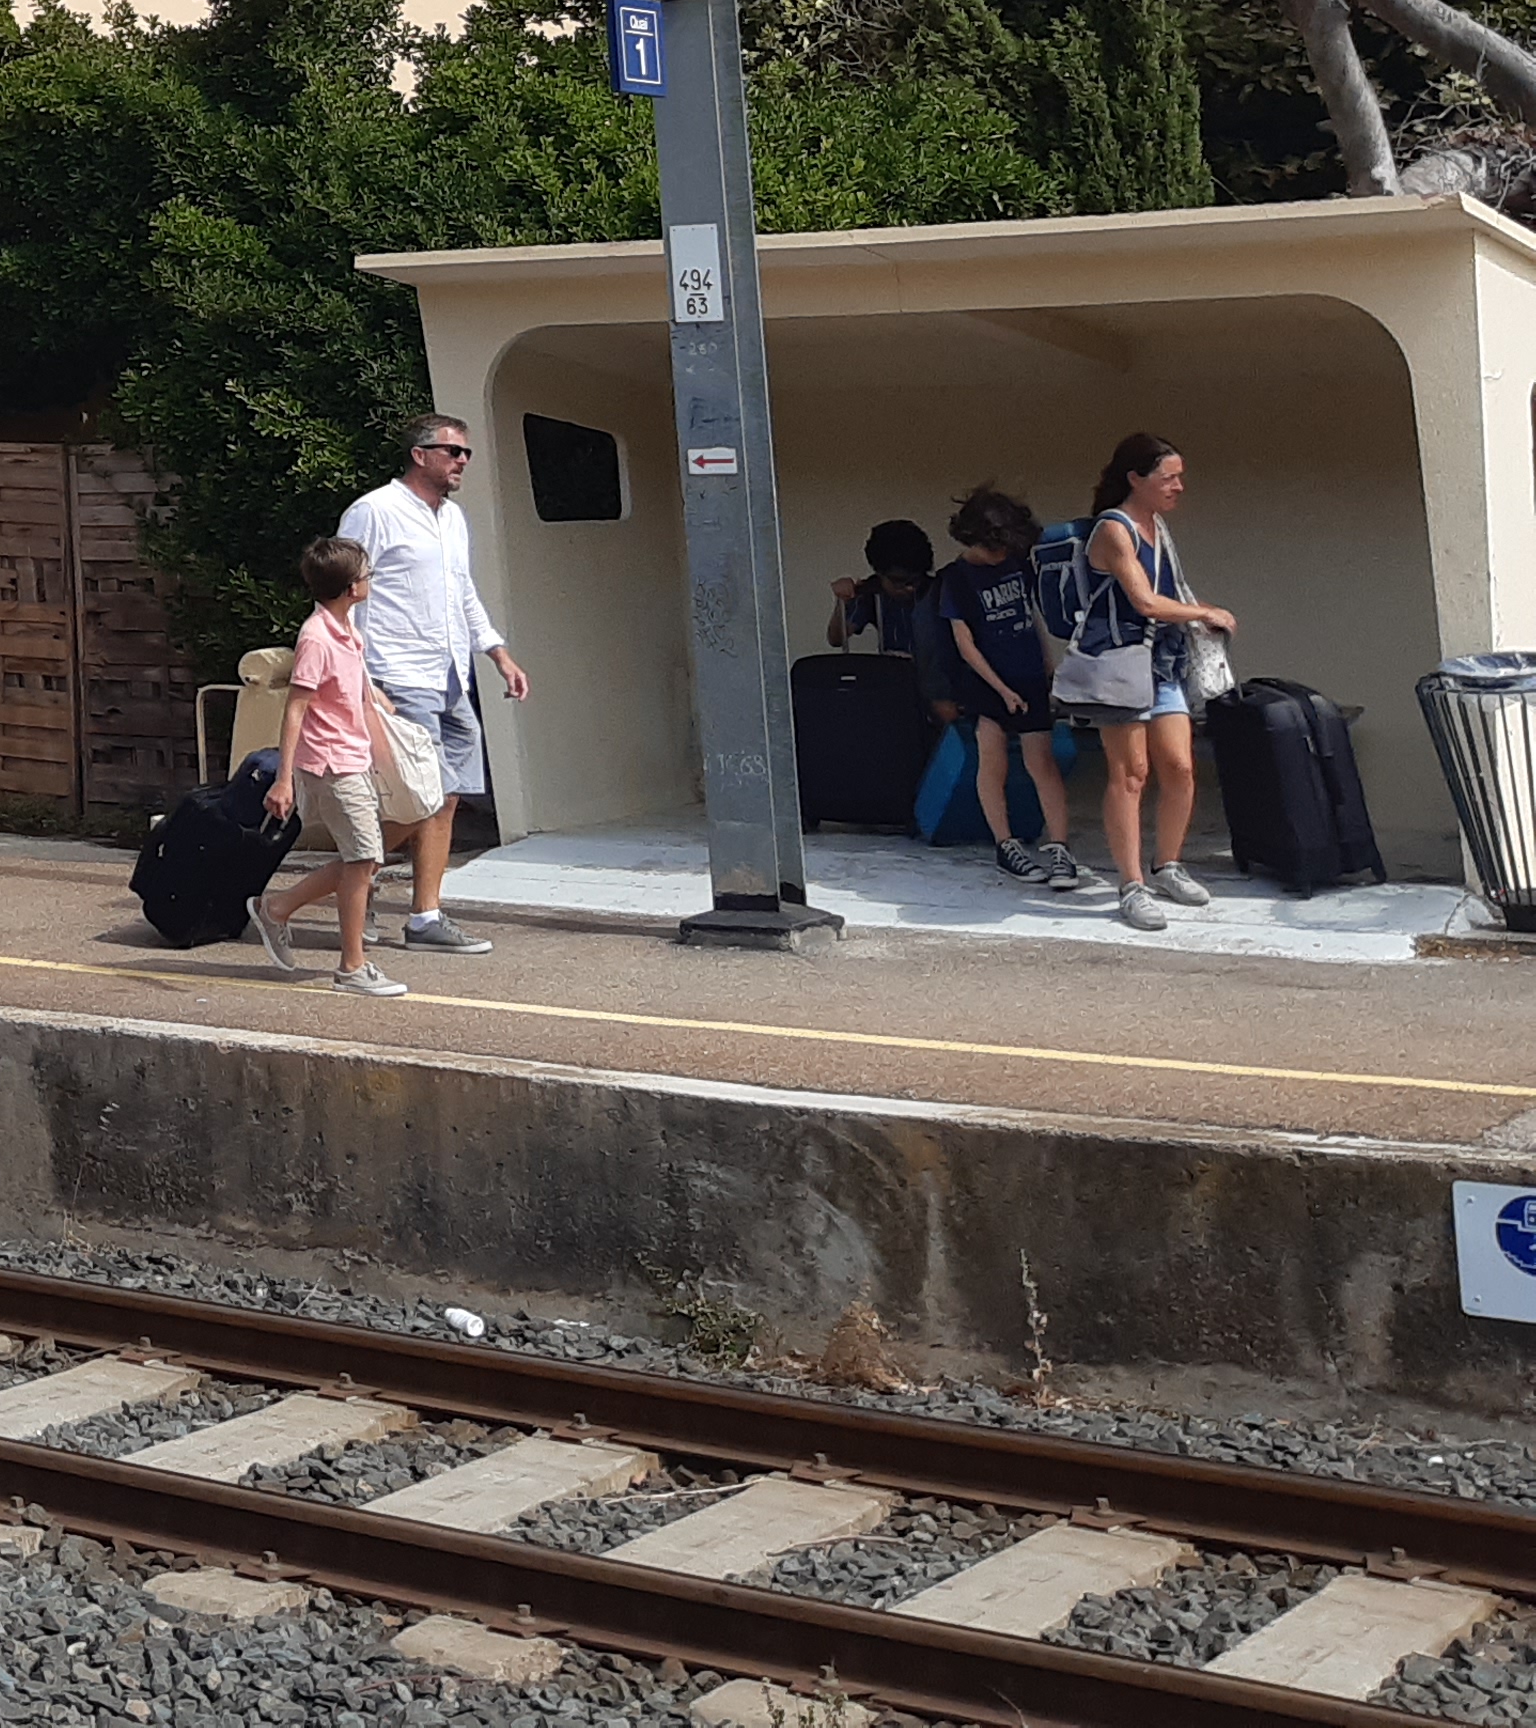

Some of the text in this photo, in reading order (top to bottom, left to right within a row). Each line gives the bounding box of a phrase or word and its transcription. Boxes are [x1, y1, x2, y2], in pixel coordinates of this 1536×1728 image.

[630, 15, 648, 30] Quai
[635, 38, 647, 76] 1
[679, 268, 713, 291] 494
[686, 297, 709, 315] 63
[982, 579, 1021, 609] PARIS
